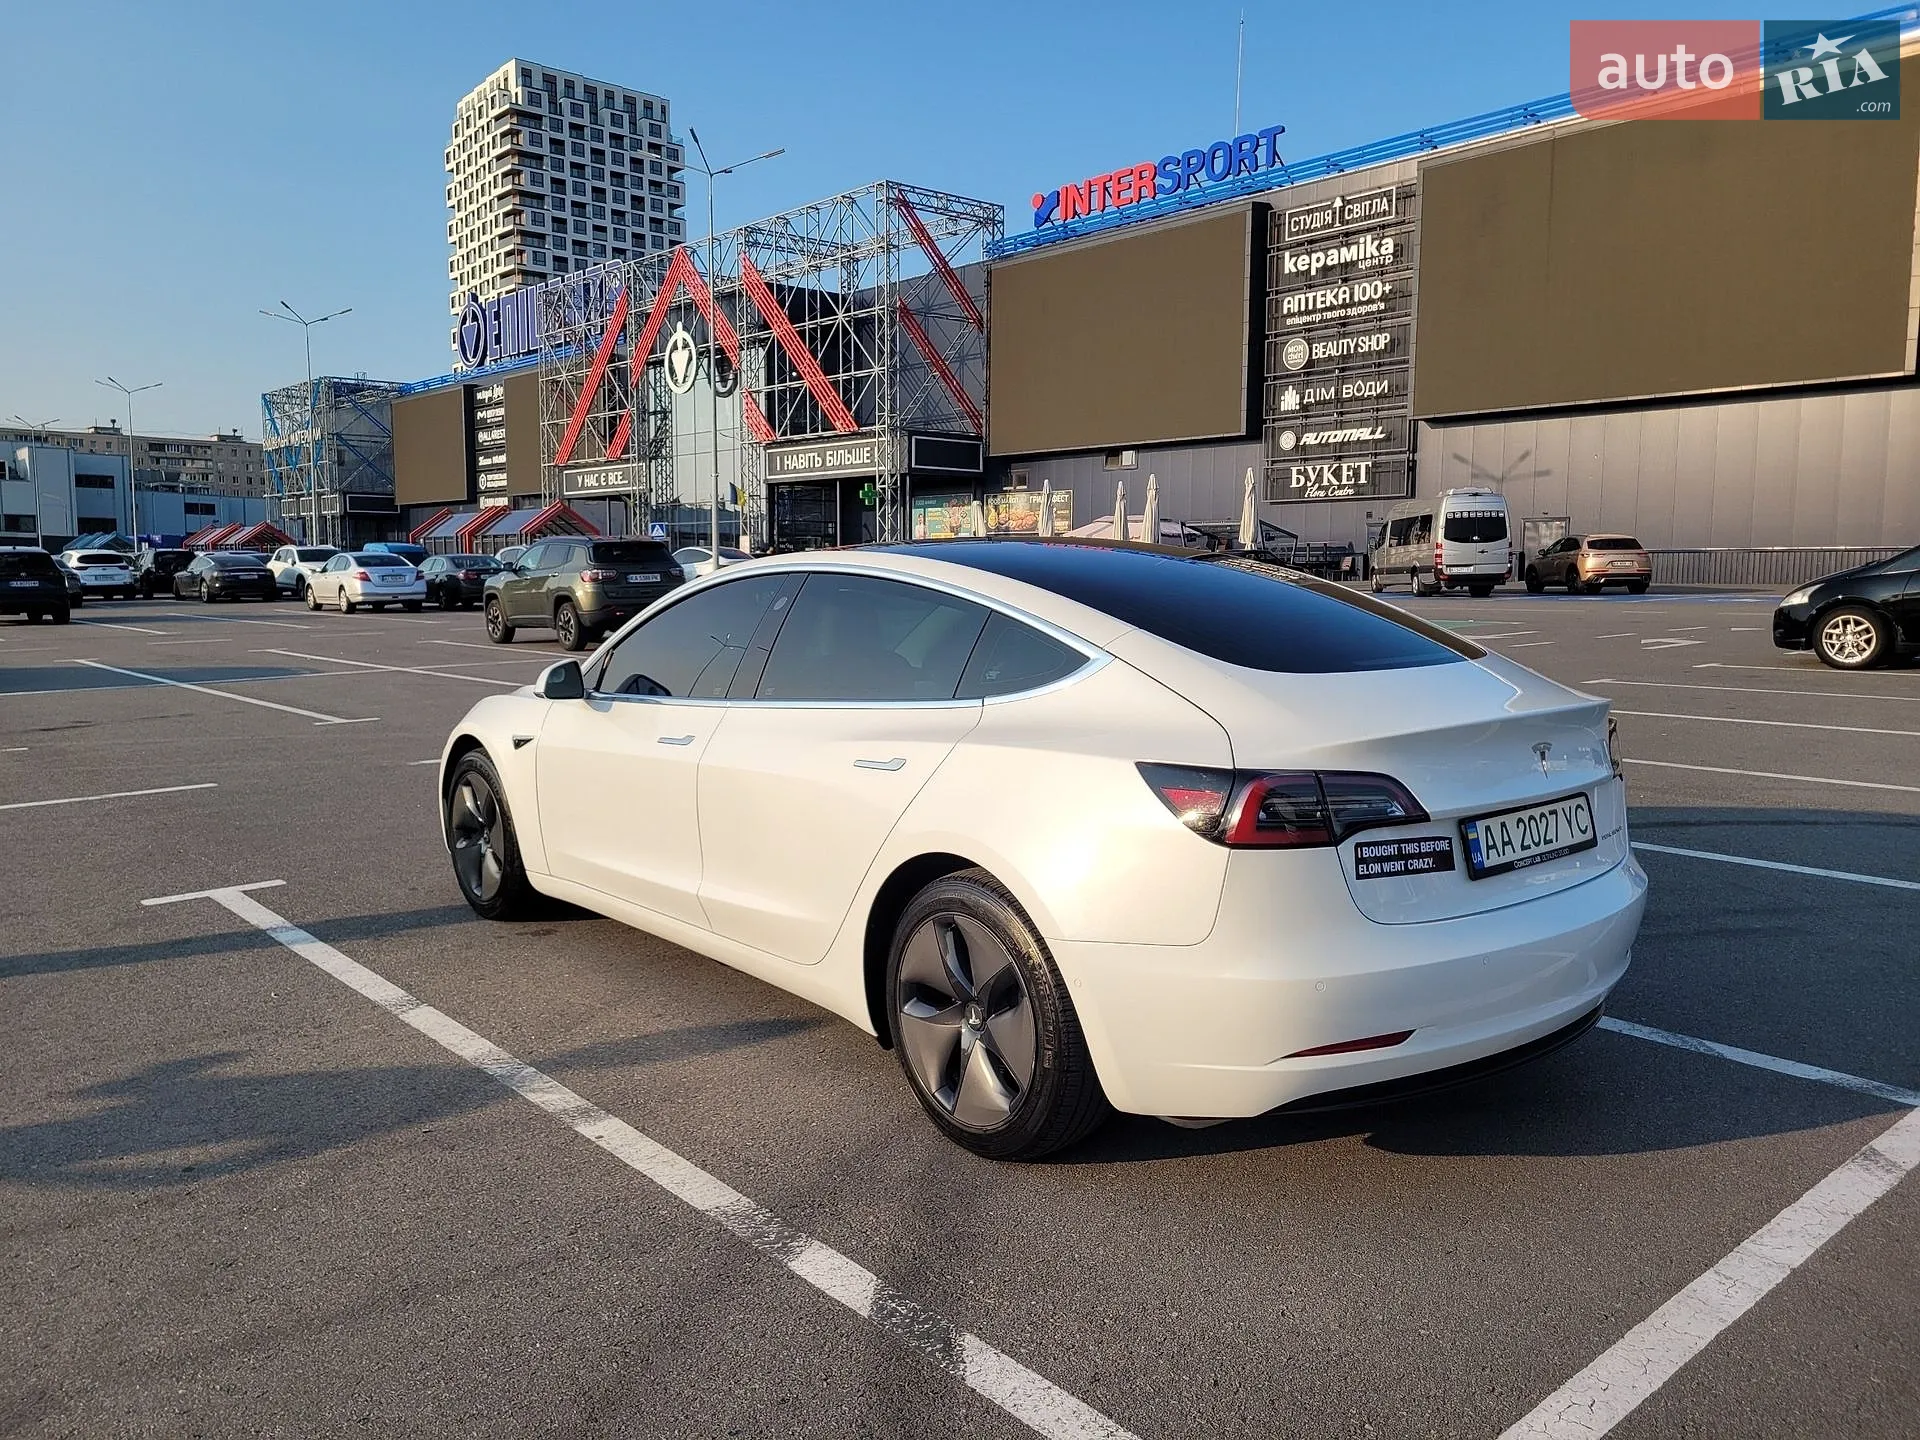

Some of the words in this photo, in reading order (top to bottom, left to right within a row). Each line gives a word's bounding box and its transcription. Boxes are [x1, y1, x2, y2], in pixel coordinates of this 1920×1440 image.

[1059, 124, 1285, 221] INTERSPORT
[1291, 209, 1332, 232] СТУДІЯ
[1344, 197, 1389, 220] СВІТЛА
[1358, 254, 1394, 270] центр
[1283, 286, 1350, 315] АПТЕКА
[1354, 280, 1392, 303] 100+
[1312, 338, 1359, 360] BEAUTY
[1357, 333, 1391, 353] SHOP
[1303, 386, 1335, 405] ДІМ
[1342, 379, 1389, 398] ВОДИ
[1300, 426, 1387, 446] AUTOMALL
[784, 452, 823, 471] НАВІТЬ
[577, 474, 583, 488] У
[584, 473, 599, 488] НАС
[600, 472, 607, 486] Є
[1289, 461, 1372, 488] БУКЕТ
[1484, 820, 1516, 860] AA
[1516, 808, 1559, 852] 2027
[1561, 803, 1589, 839] YC
[1357, 847, 1361, 859] I
[1363, 844, 1399, 858] BOUGHT
[1400, 842, 1420, 855] THIS
[1420, 840, 1451, 853] BEFORE
[1471, 852, 1483, 864] UA
[1358, 863, 1382, 876] ELON
[1382, 861, 1406, 873] WENT
[1407, 858, 1436, 870] CRAZY.
